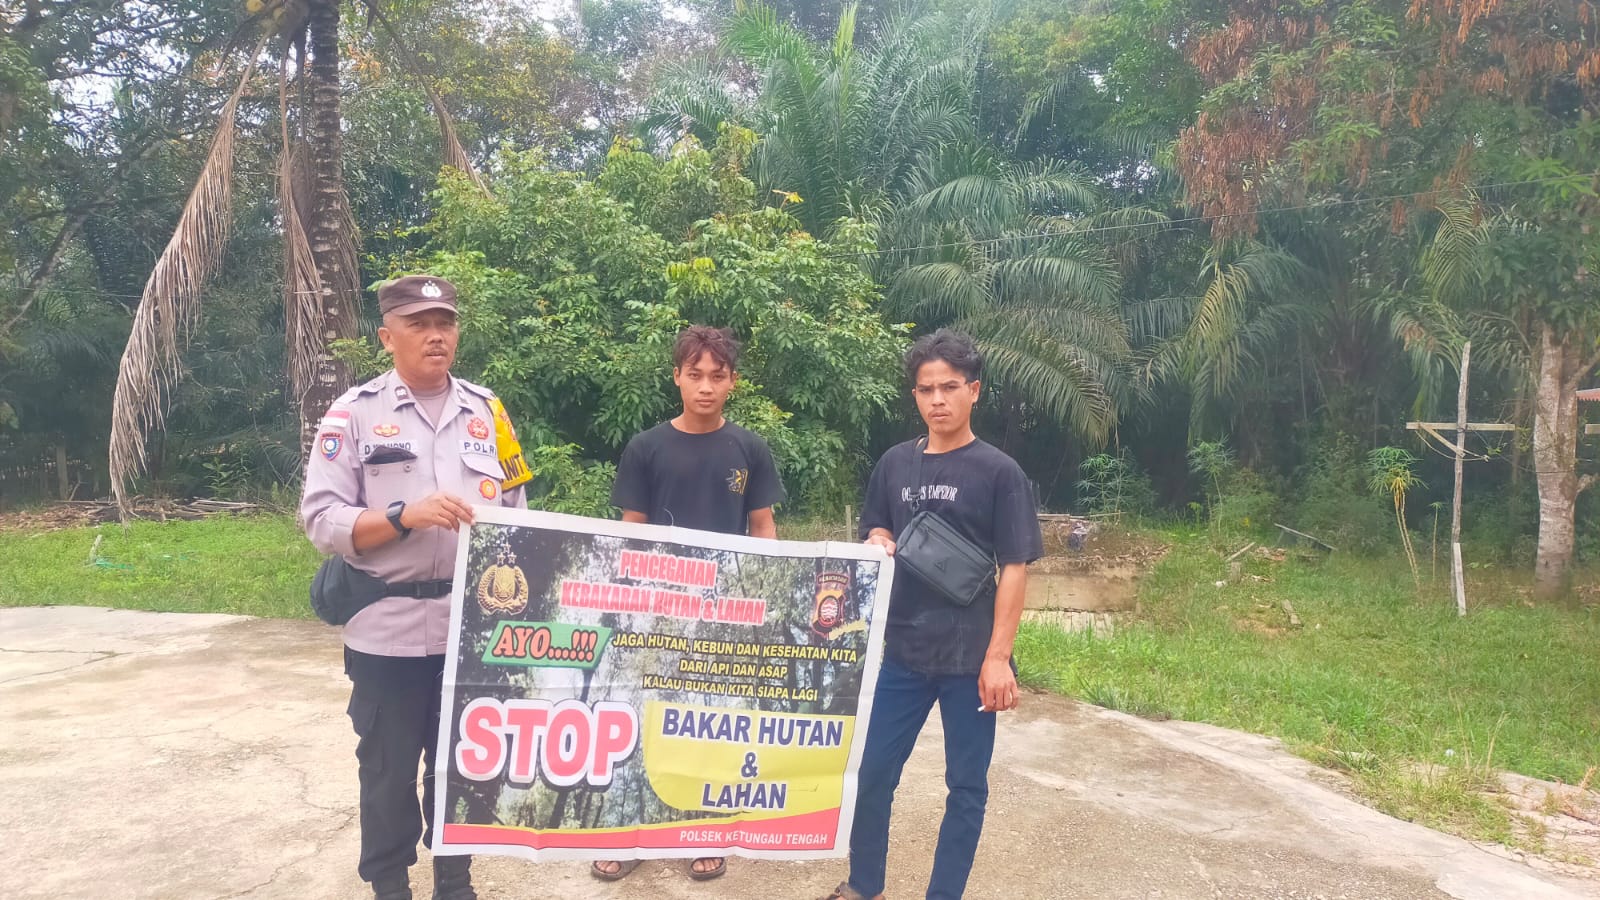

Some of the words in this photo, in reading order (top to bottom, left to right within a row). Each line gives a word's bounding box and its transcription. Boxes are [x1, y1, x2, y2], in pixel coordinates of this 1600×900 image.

[621, 551, 717, 588] PENCEGAHAN
[560, 581, 649, 613] KEBAKARAN
[652, 590, 702, 619] HUTAN
[703, 600, 714, 620] &
[716, 597, 766, 625] LAHAN
[613, 633, 645, 647] JAGA
[648, 635, 690, 653] HUTAN,
[693, 641, 735, 656] KEBUN
[736, 643, 760, 656] DAN
[763, 645, 829, 661] KESEHATAN
[831, 649, 857, 662] KITA
[680, 659, 708, 674] DARI
[709, 661, 729, 675] API
[732, 663, 755, 677] DAN
[759, 665, 788, 678] ASAP
[643, 675, 681, 690] KALAU
[684, 680, 726, 695] BUKAN
[728, 683, 755, 697] KITA
[757, 686, 789, 700] SIAPA
[791, 688, 818, 702] LAGI
[662, 708, 750, 743] BAKAR
[758, 717, 844, 746] HUTAN
[459, 703, 635, 780] STOP
[741, 752, 758, 778] &
[701, 783, 787, 809] LAHAN
[679, 830, 722, 842] POLSEK
[725, 830, 783, 845] KETUNGAU
[786, 833, 828, 845] TENGAH
